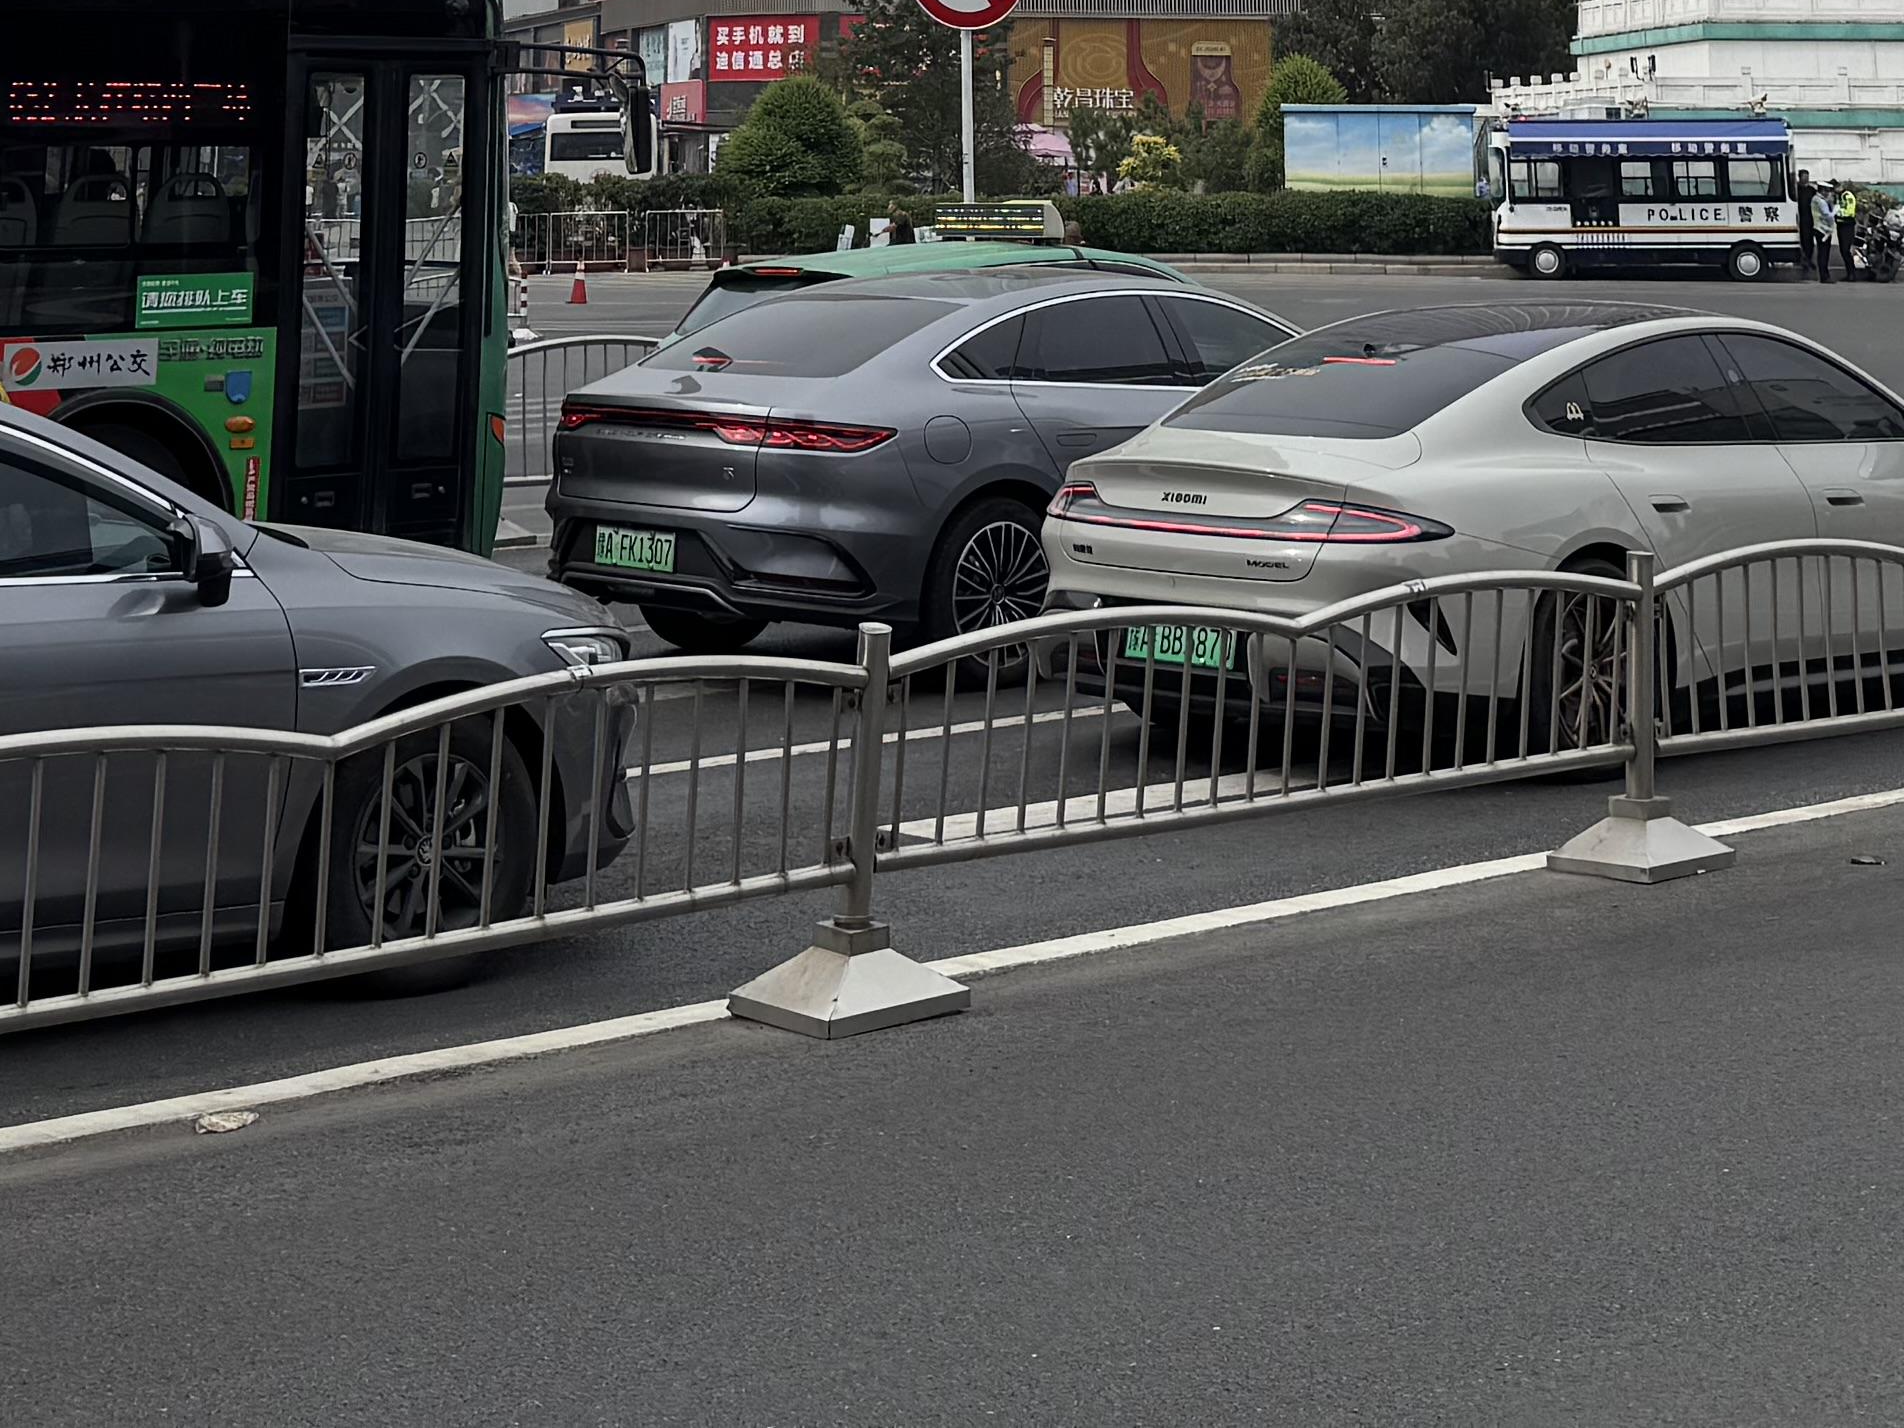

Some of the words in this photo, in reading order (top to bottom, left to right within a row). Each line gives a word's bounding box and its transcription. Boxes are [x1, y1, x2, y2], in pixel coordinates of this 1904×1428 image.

[716, 24, 805, 46] 买手机就到
[1647, 206, 1724, 222] POLICE
[1738, 205, 1781, 223] 警察
[48, 349, 151, 377] 郑州公交
